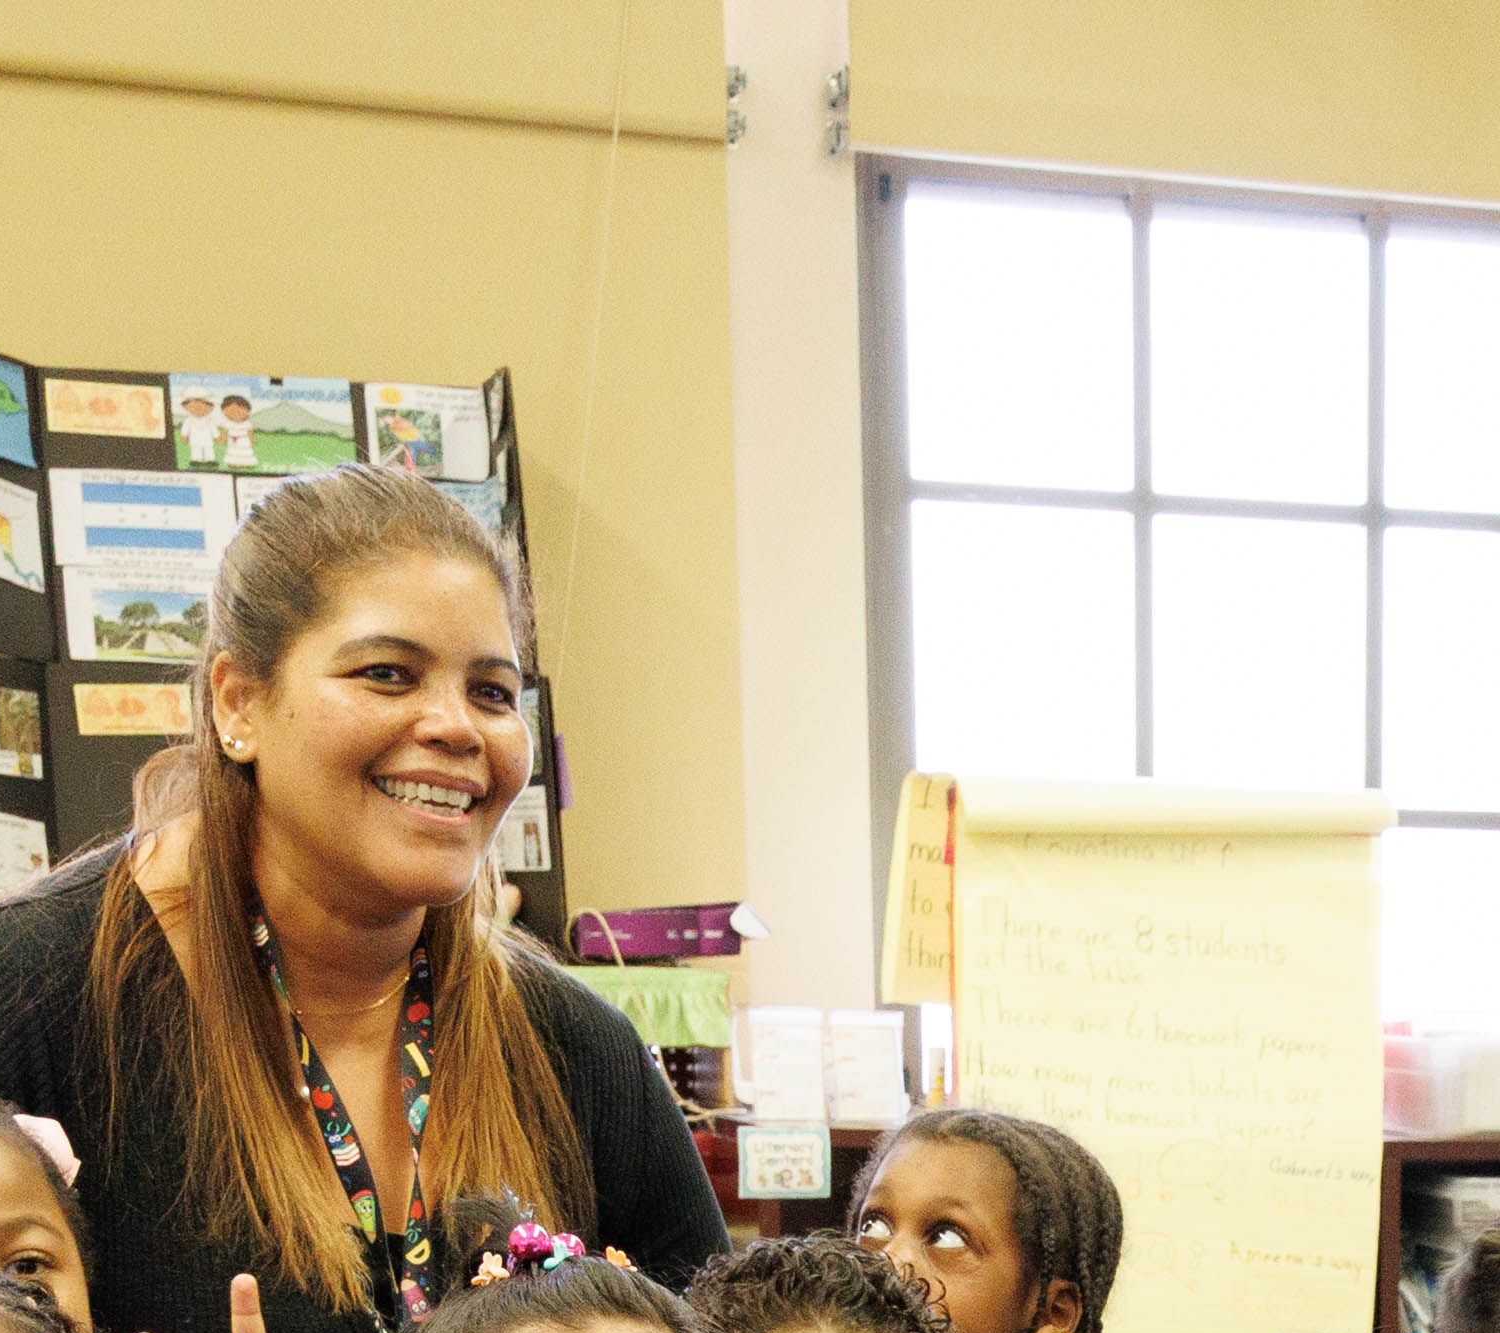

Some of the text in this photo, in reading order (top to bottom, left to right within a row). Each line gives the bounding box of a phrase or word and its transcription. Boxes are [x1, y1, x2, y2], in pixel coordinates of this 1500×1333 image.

[977, 896, 1289, 966] There are 8 students
[974, 944, 1009, 970] at
[1023, 947, 1070, 976] the
[971, 986, 1055, 1029] There
[1257, 1027, 1332, 1062] papers
[963, 1041, 1019, 1080] How
